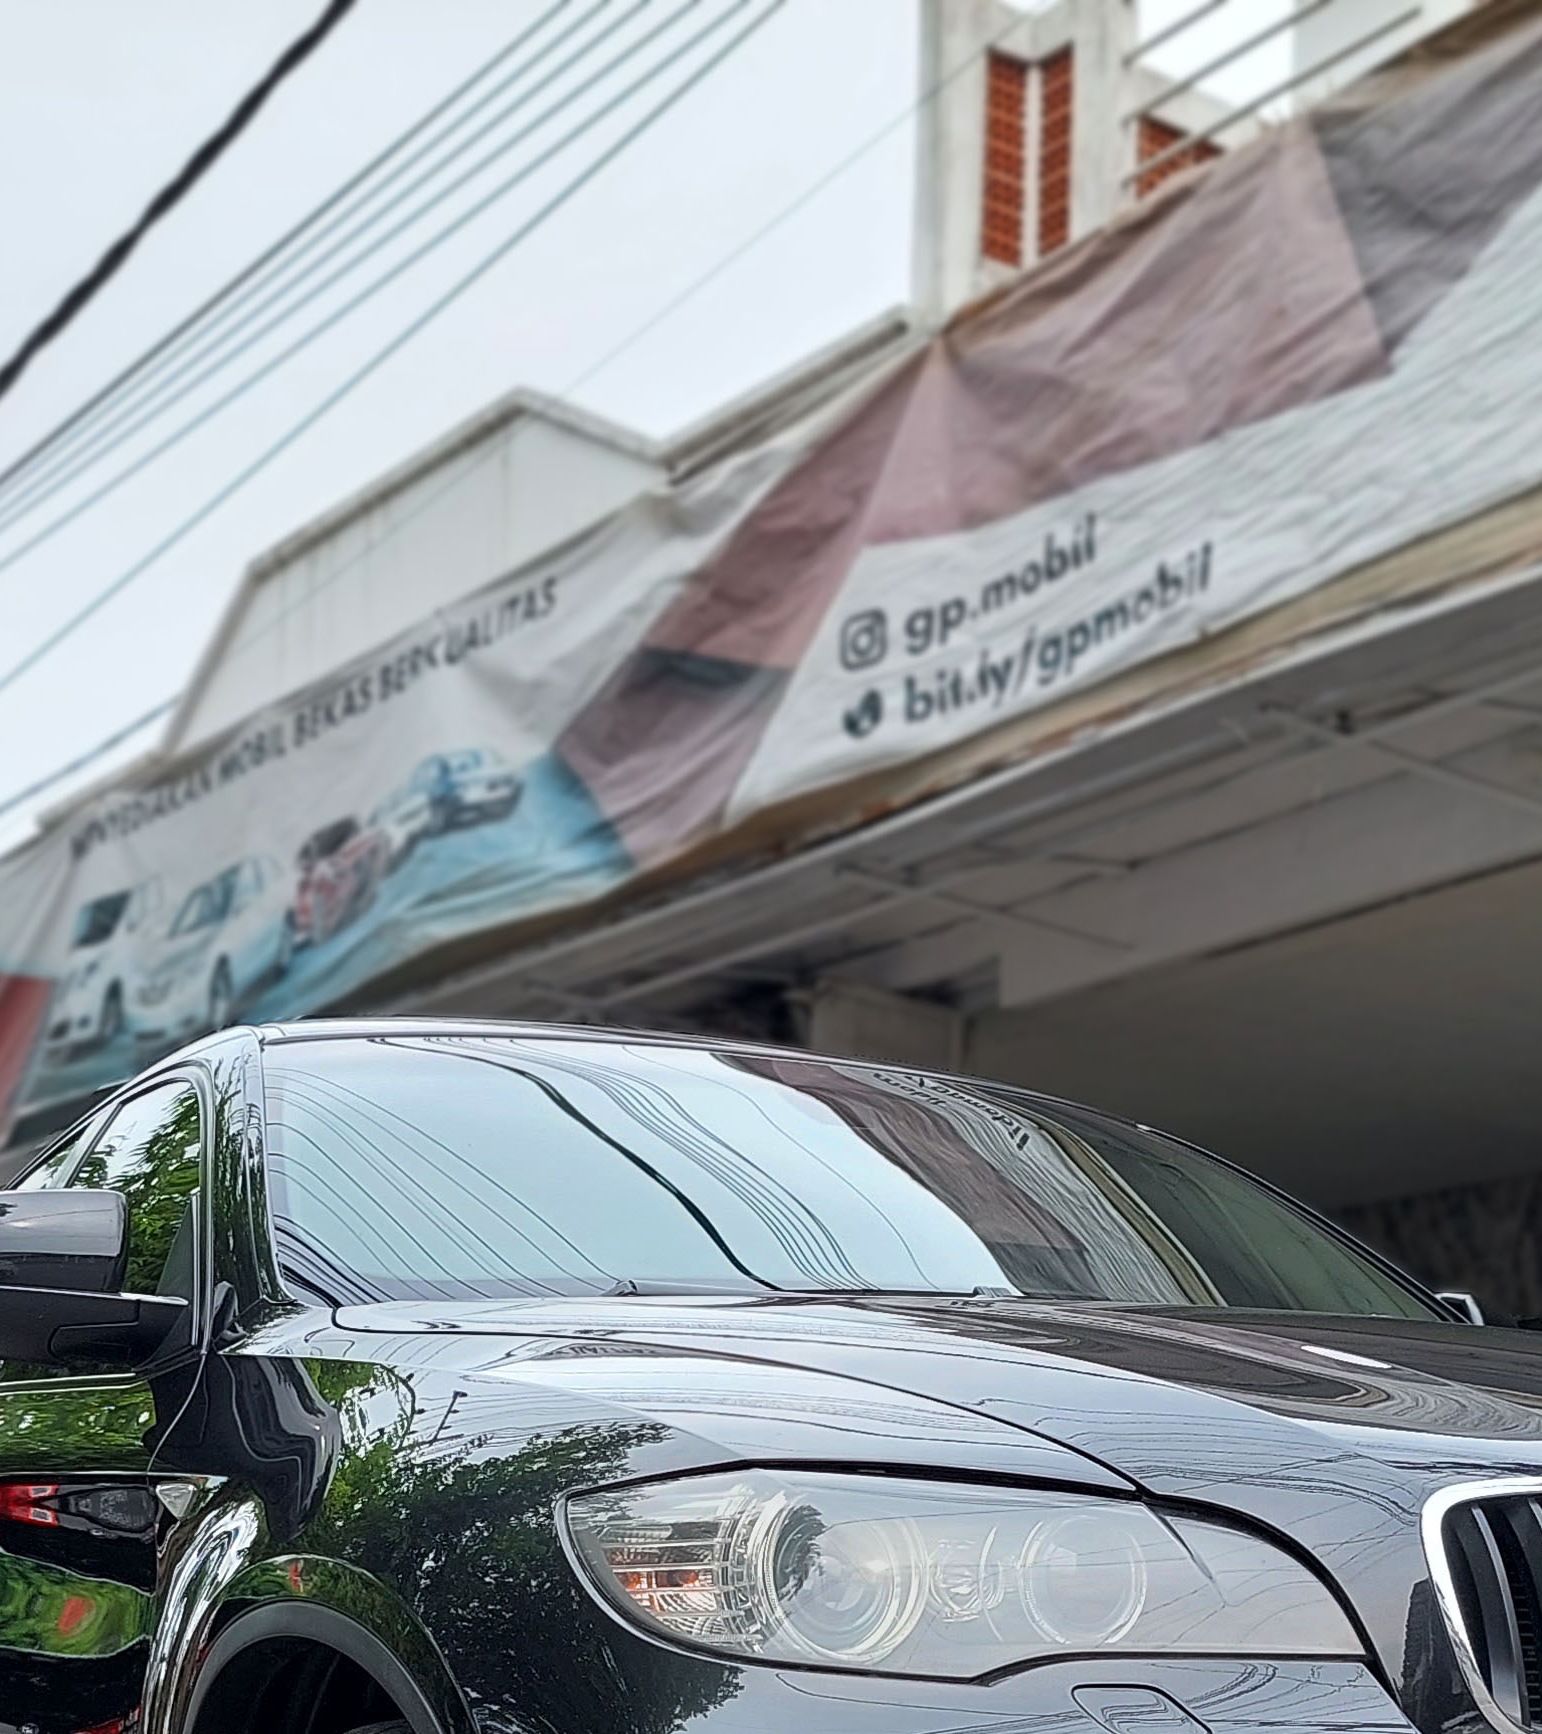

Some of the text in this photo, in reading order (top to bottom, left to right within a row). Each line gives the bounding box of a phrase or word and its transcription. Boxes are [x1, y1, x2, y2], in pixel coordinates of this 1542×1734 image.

[903, 513, 1098, 655] gp.mobil
[903, 541, 1214, 725] bit.ly/gpmobil
[293, 674, 372, 749] BEKAS
